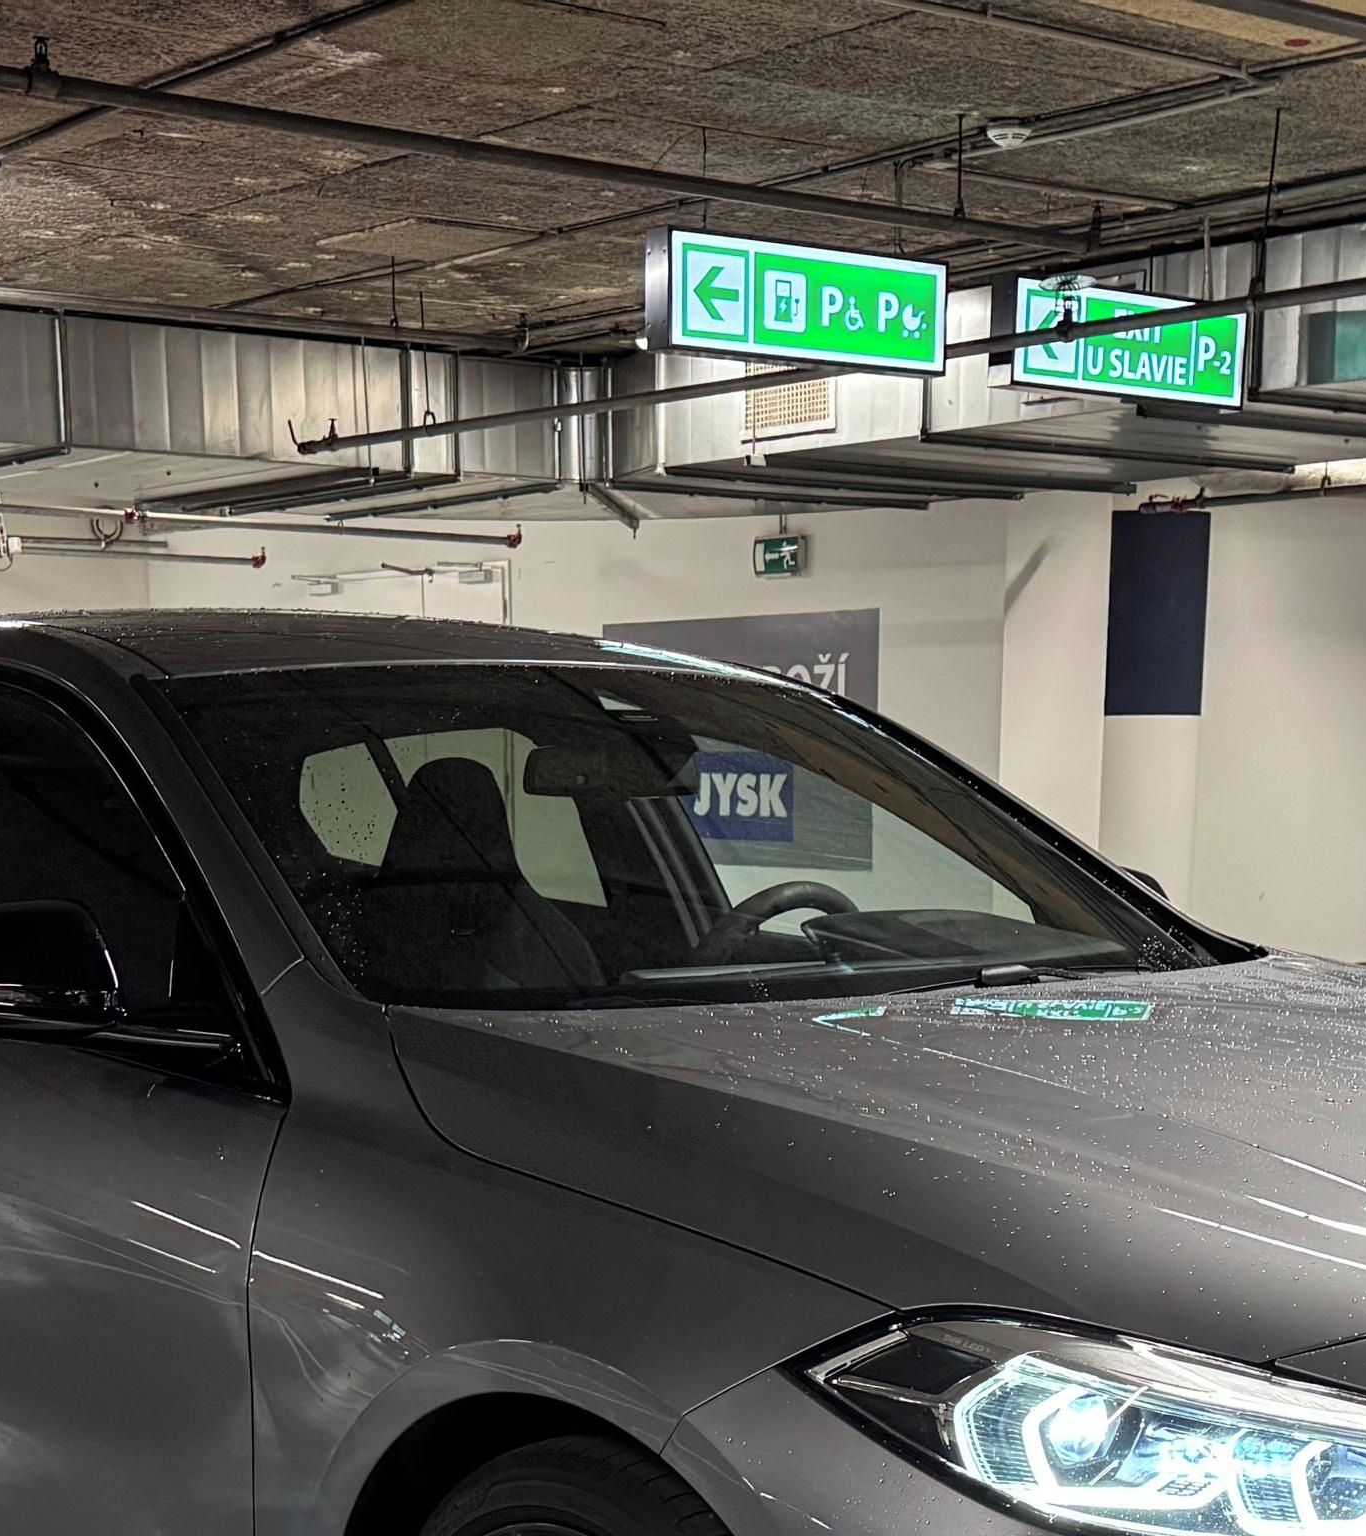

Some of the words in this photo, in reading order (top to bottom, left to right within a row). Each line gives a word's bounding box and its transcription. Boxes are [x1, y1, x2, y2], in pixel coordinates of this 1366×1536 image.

[821, 285, 844, 327] P
[877, 291, 900, 333] P
[1086, 345, 1104, 376] U
[1108, 348, 1188, 386] SLAVIE
[693, 772, 789, 819] JYSK
